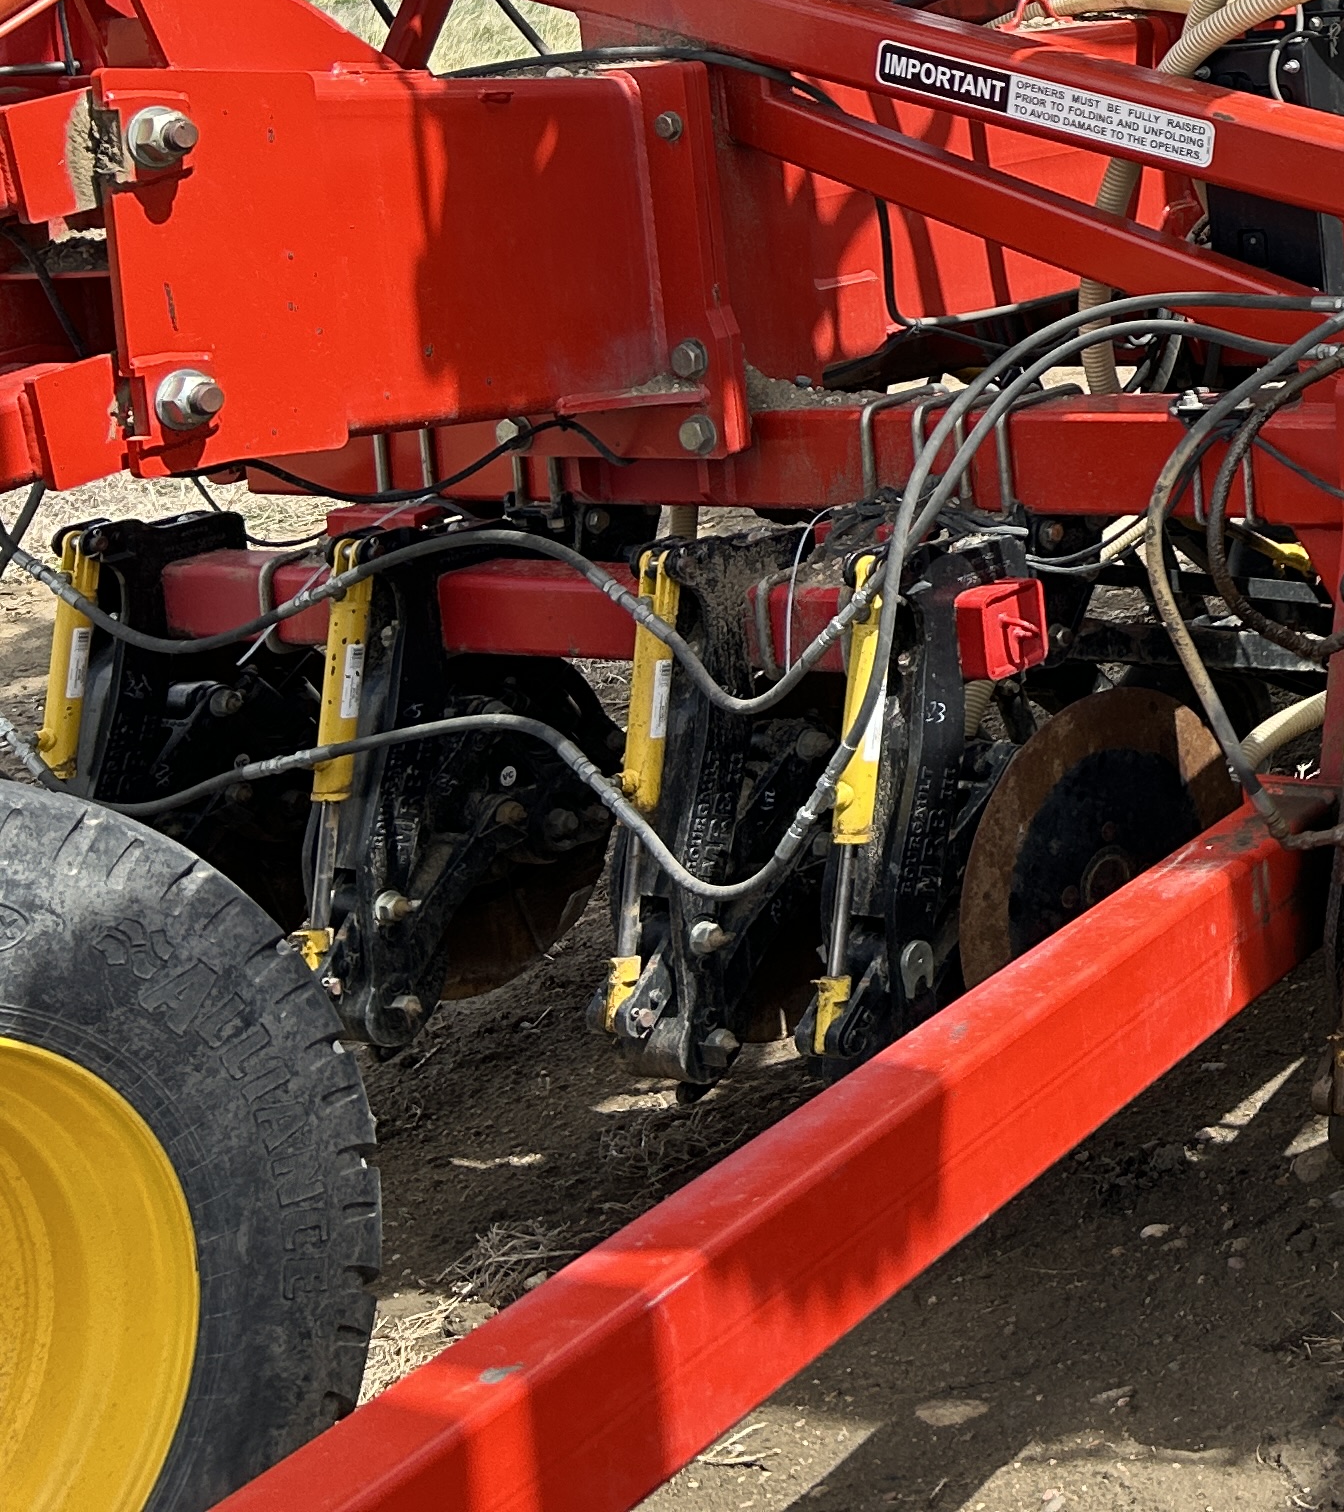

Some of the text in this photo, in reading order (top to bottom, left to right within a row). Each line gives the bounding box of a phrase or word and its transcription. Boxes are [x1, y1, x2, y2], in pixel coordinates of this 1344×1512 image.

[884, 51, 1006, 104] IMPORTANT
[1014, 103, 1202, 162] TO AVOID DAMAGE TO THE OPENERS.
[1015, 92, 1204, 149] PRIOR TO FOLDING AND UNFOLDING
[1016, 80, 1206, 136] OPENERS MUST BE FULLY RAISED
[925, 700, 947, 724] 23
[138, 958, 329, 1300] ALLIANCE
